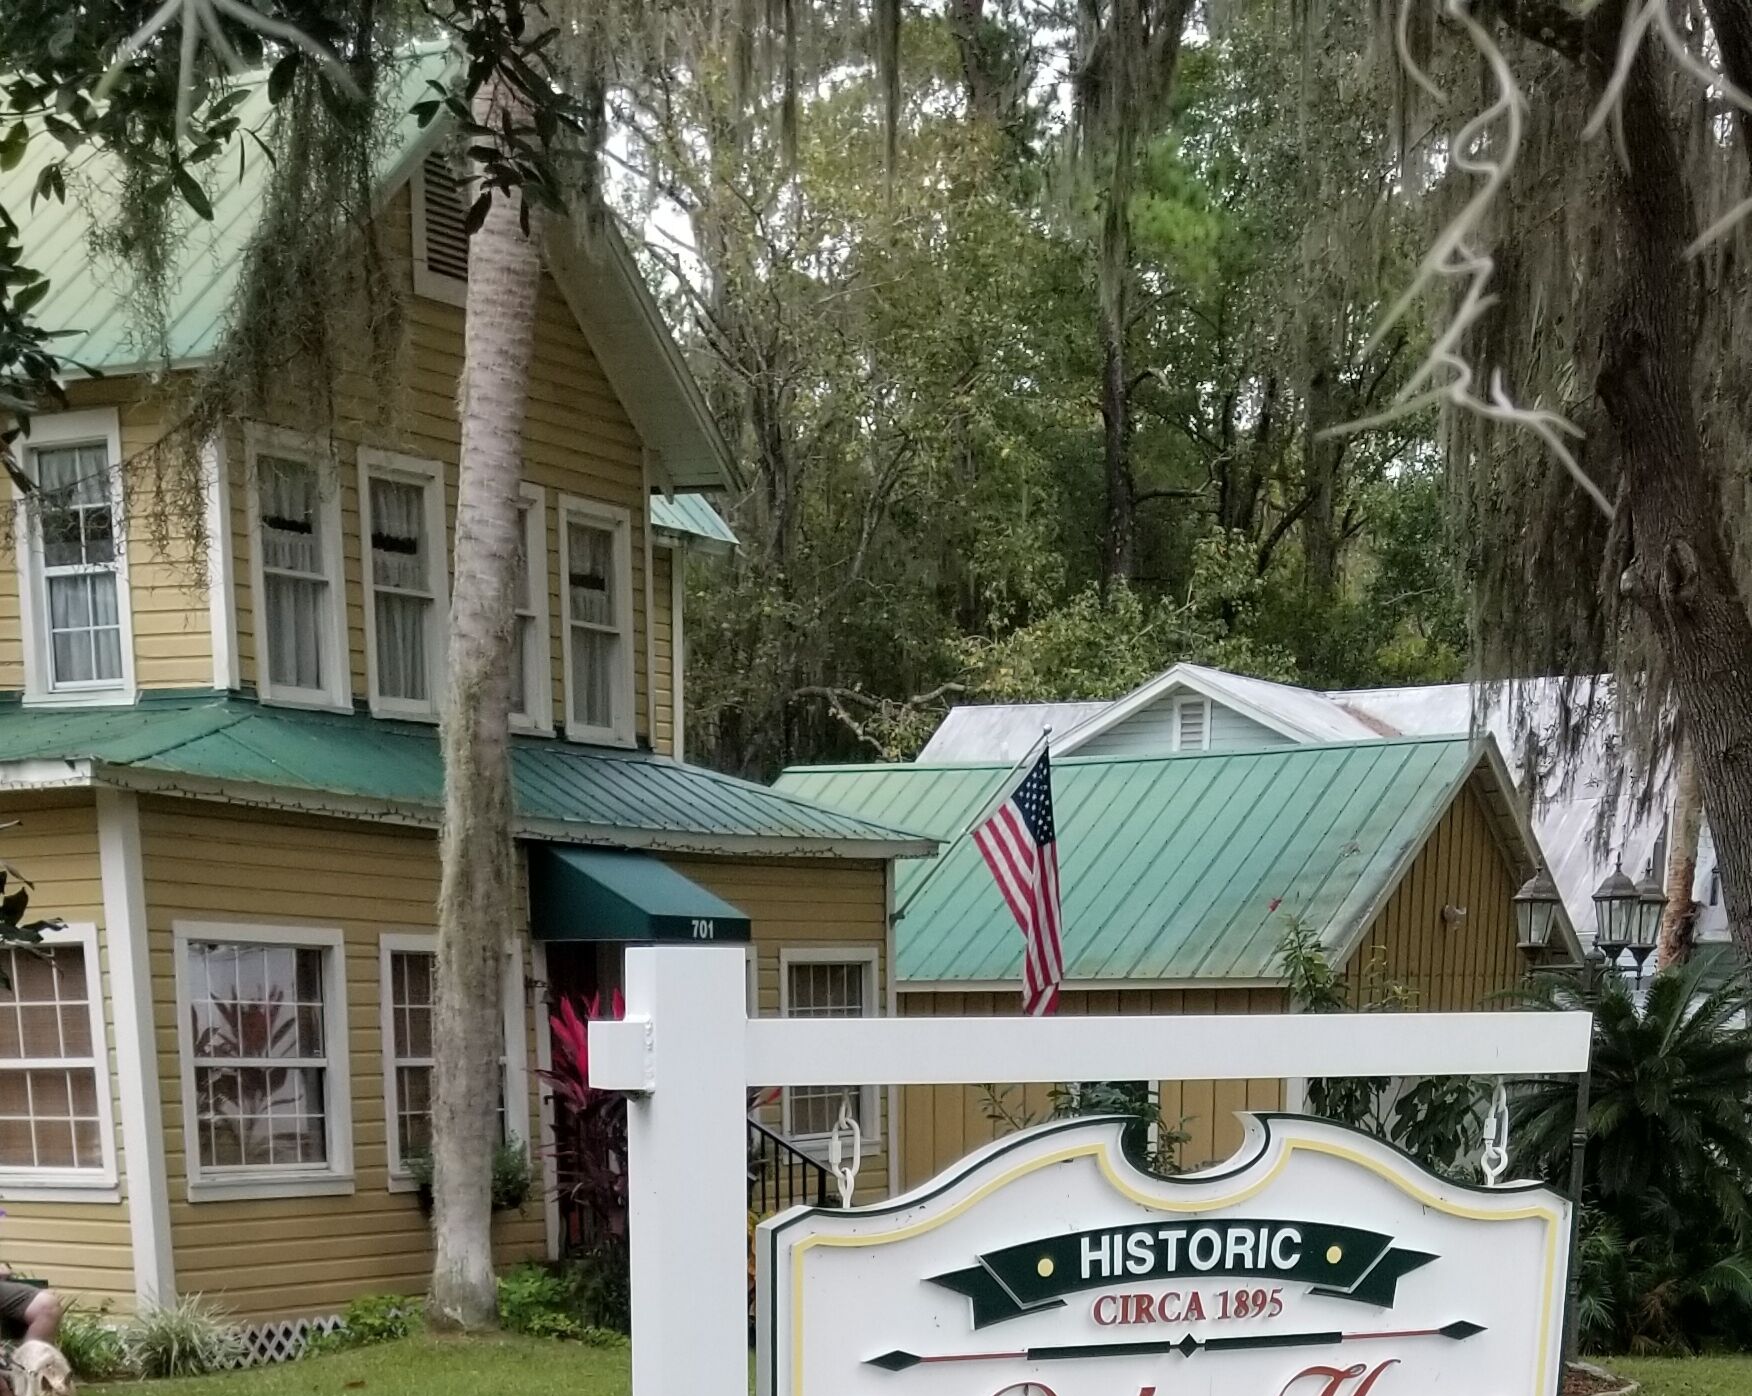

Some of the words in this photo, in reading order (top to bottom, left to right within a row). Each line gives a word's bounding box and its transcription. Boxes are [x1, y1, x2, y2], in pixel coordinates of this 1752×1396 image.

[692, 919, 714, 939] 701
[1081, 1227, 1302, 1278] HISTORIC
[1093, 1291, 1206, 1326] CIRCA
[1217, 1288, 1283, 1321] 1895
